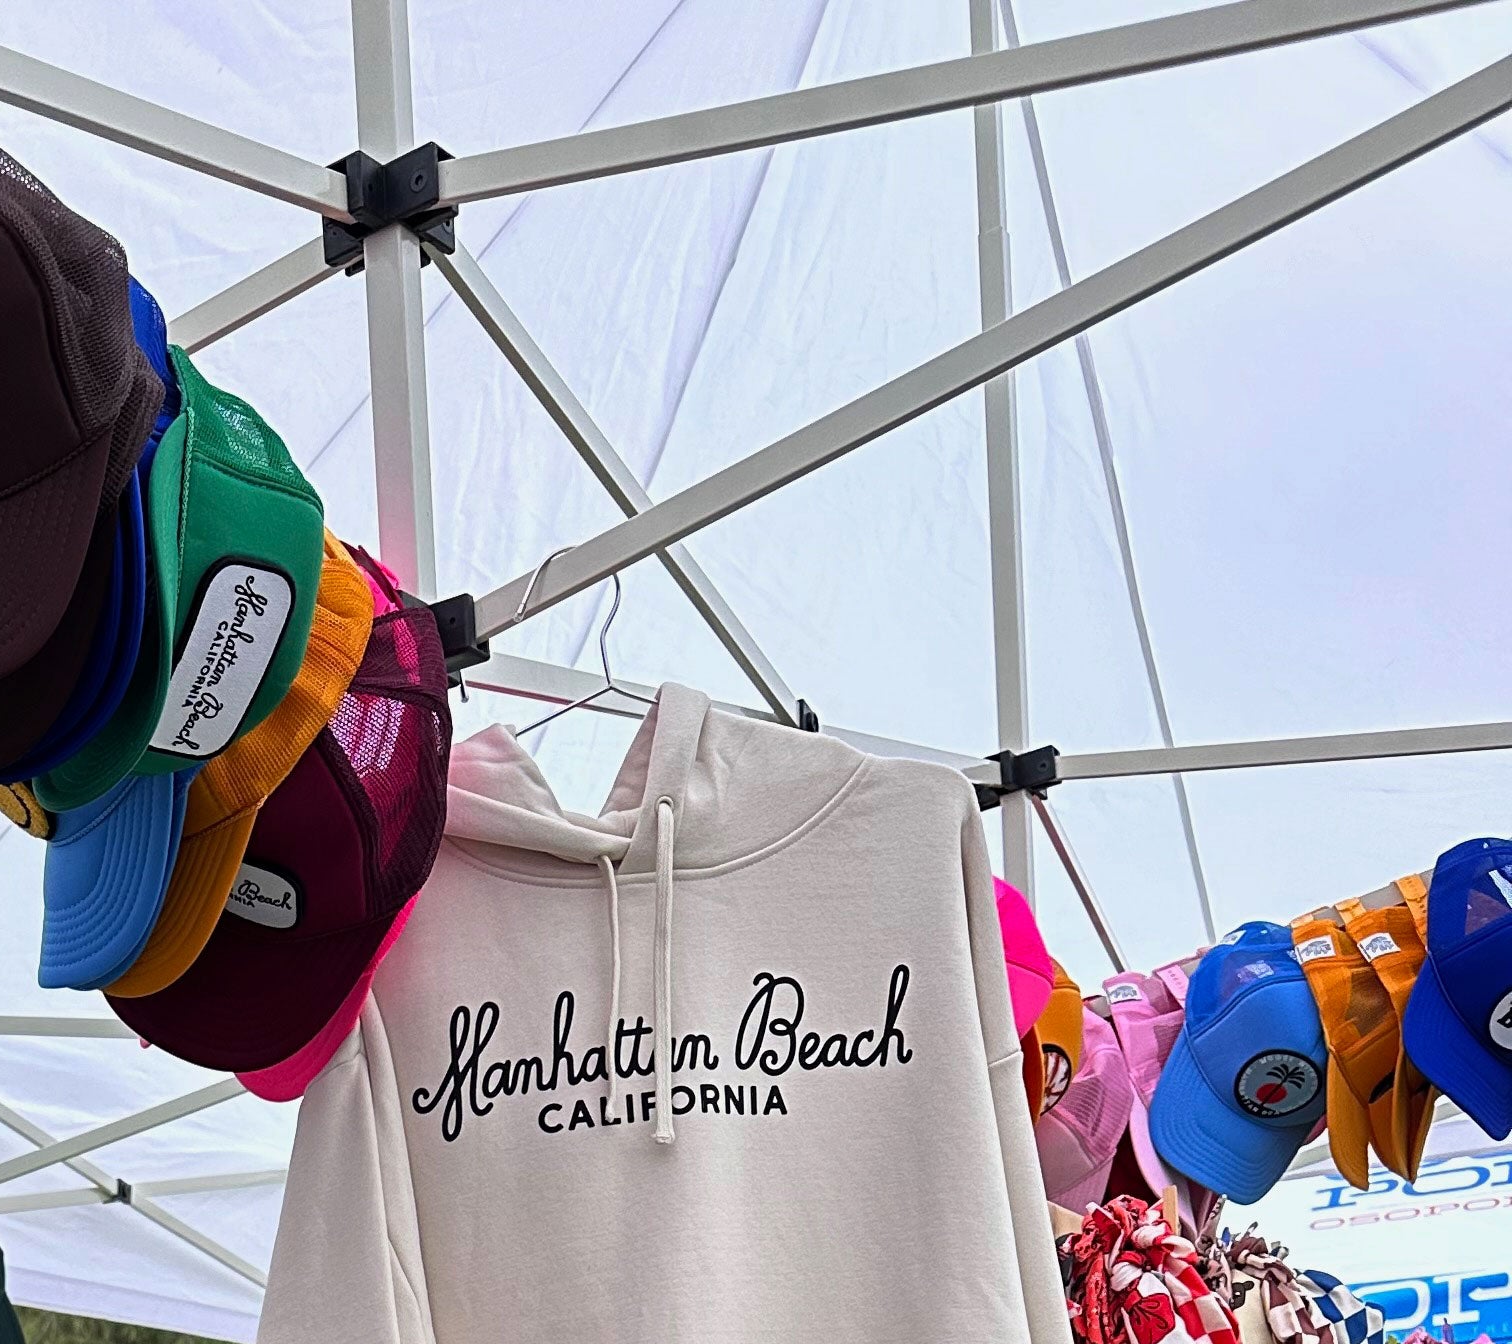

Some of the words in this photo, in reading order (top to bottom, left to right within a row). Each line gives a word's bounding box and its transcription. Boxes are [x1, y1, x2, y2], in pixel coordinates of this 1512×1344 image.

[181, 620, 229, 708] CALIFORNIA
[206, 575, 268, 688] Manhattan
[171, 692, 224, 750] Beach
[735, 963, 913, 1077] Beach
